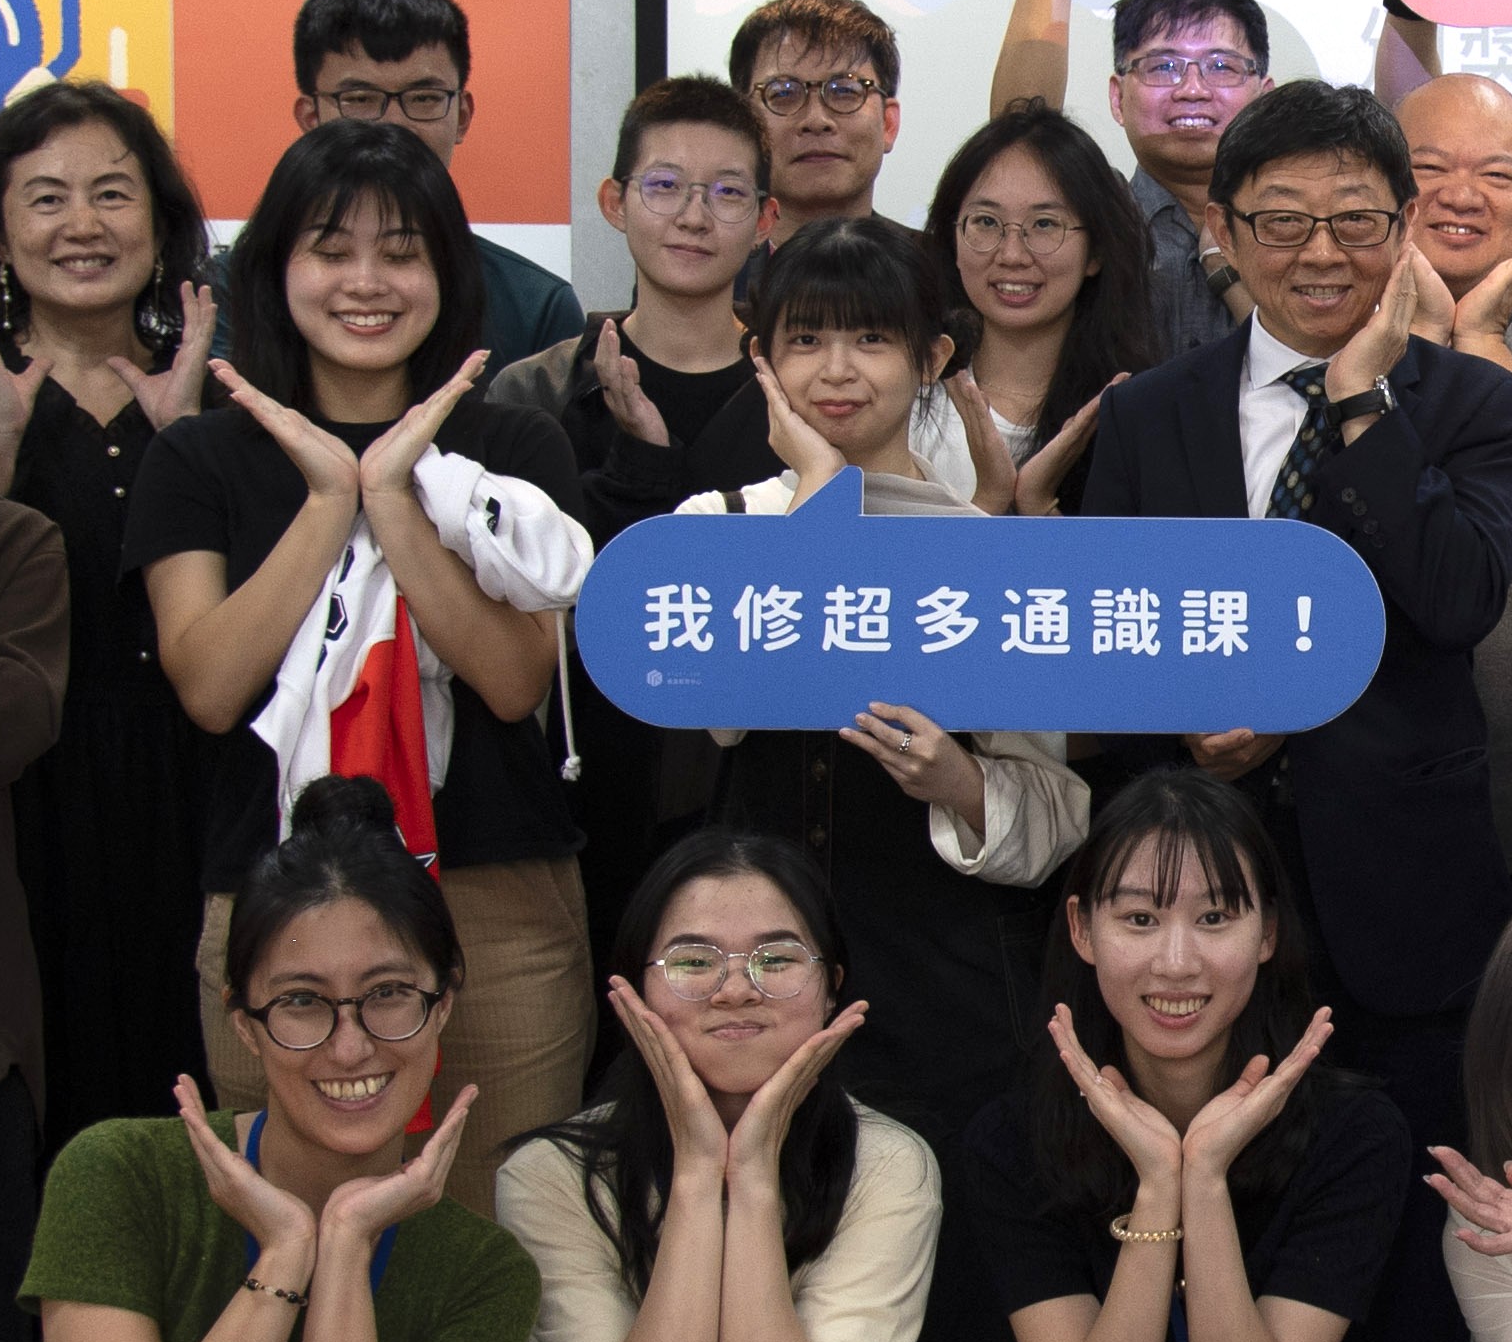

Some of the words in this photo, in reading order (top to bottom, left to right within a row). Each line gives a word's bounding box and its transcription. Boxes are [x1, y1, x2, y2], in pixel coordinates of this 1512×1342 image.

[643, 584, 1315, 657] 我修超多通識課！
